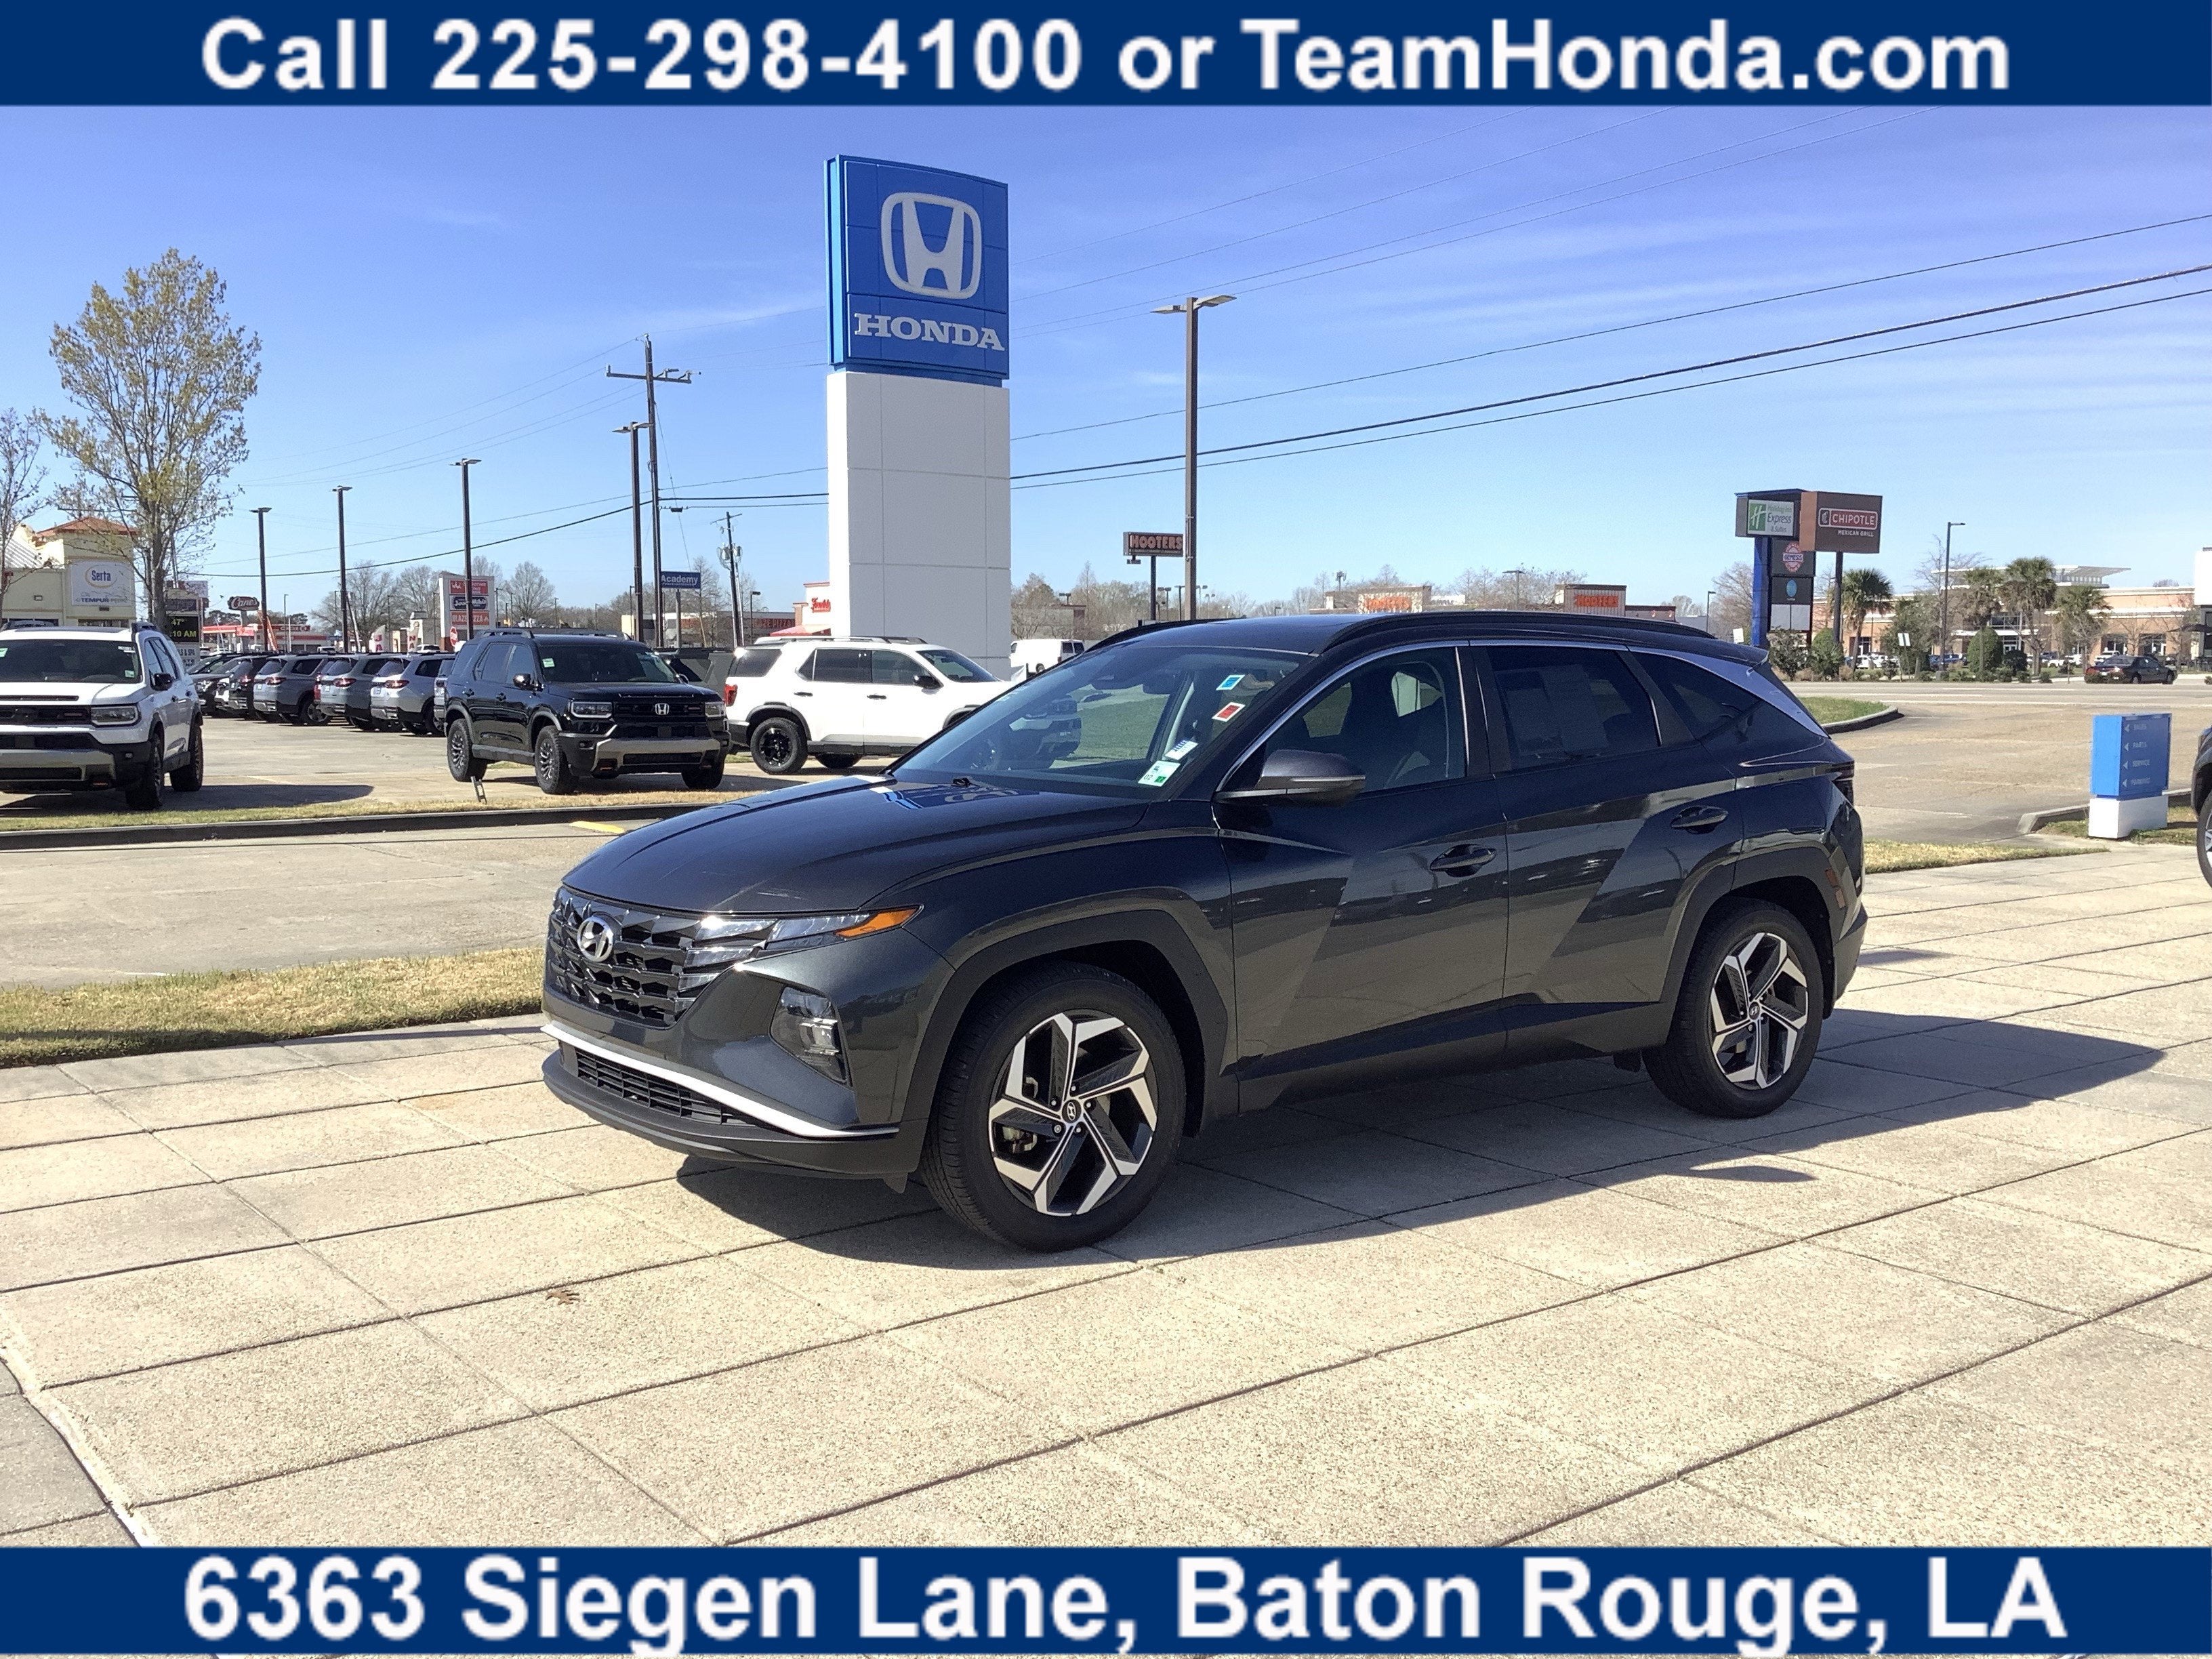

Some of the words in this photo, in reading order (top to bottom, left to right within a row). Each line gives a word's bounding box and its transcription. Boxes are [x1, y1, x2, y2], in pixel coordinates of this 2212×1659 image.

[855, 313, 1005, 351] HONDA
[1767, 512, 1791, 525] Express
[1832, 513, 1875, 526] CHIPOTLE
[1130, 535, 1183, 550] HOOTERS
[91, 570, 111, 581] Serta
[661, 574, 699, 585] Academy
[231, 597, 258, 609] Cane's
